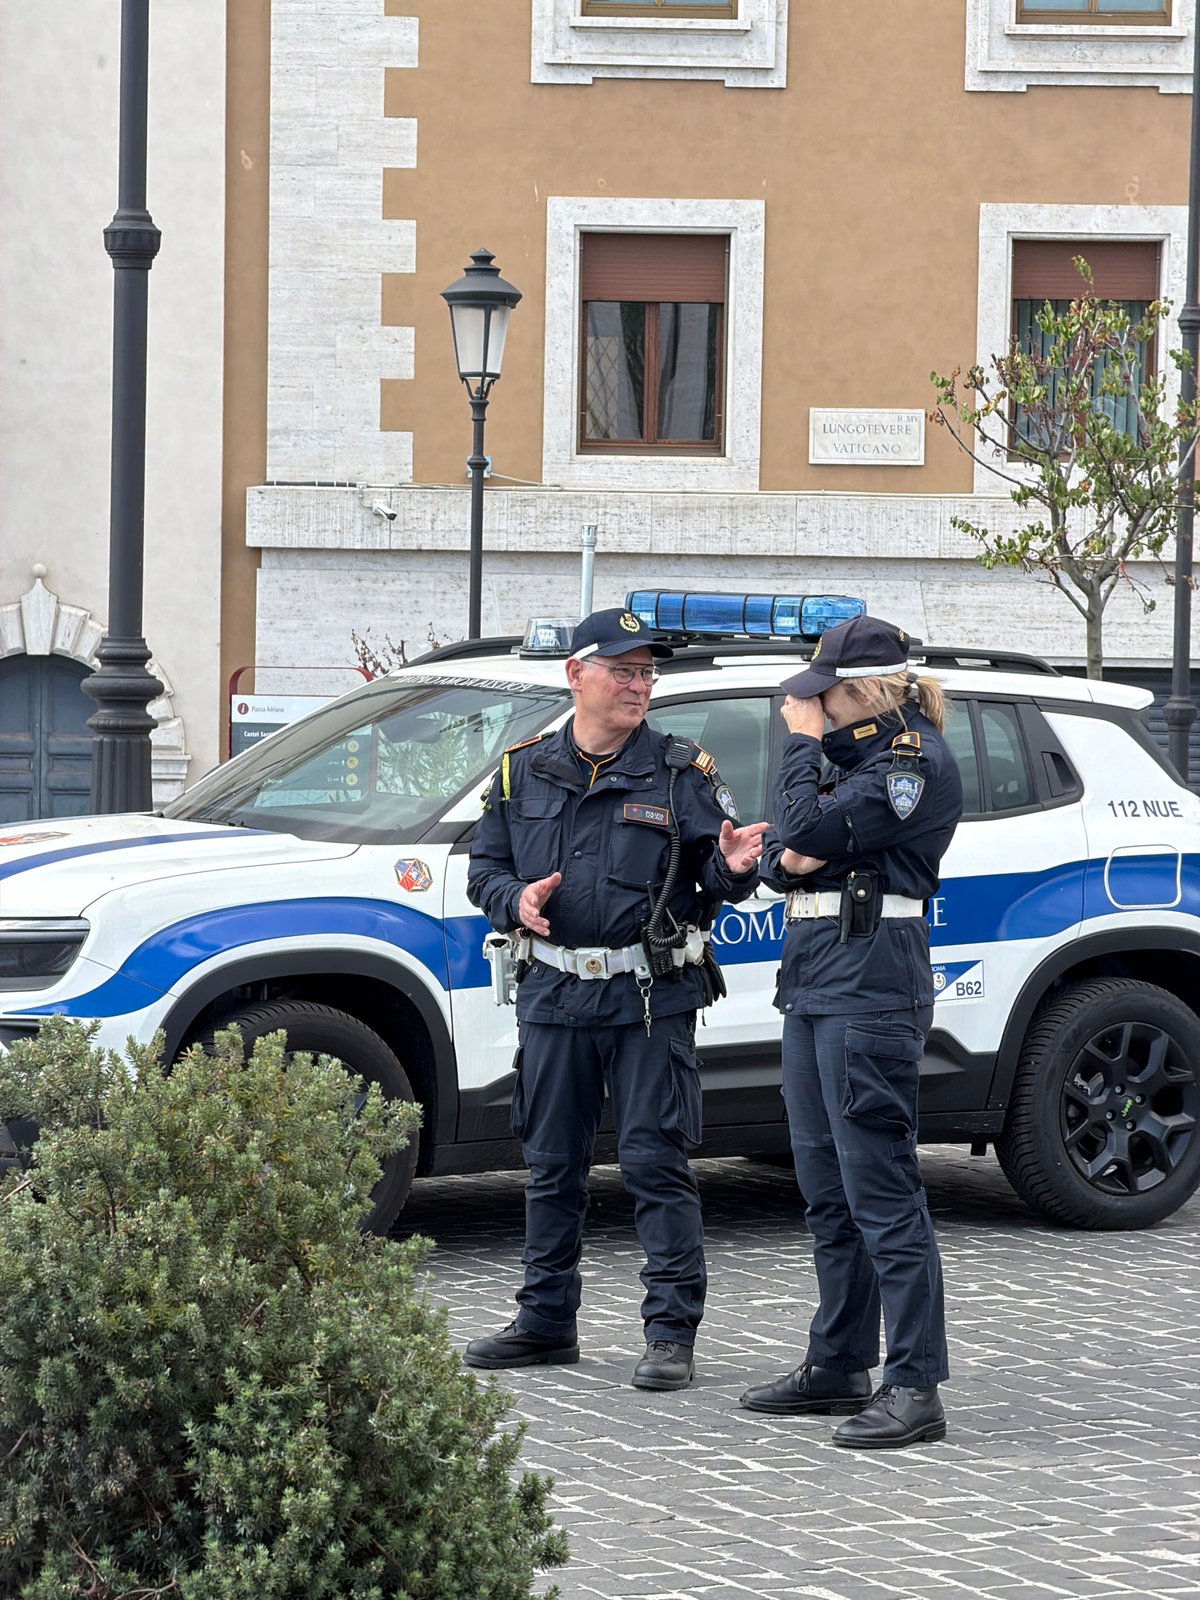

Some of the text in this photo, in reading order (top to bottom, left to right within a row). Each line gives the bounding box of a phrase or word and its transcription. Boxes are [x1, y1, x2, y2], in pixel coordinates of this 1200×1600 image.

[823, 423, 912, 435] LUNGOTEVERE
[833, 443, 902, 454] VATICANO
[1107, 800, 1184, 818] 112 NUE
[955, 980, 982, 997] B62
